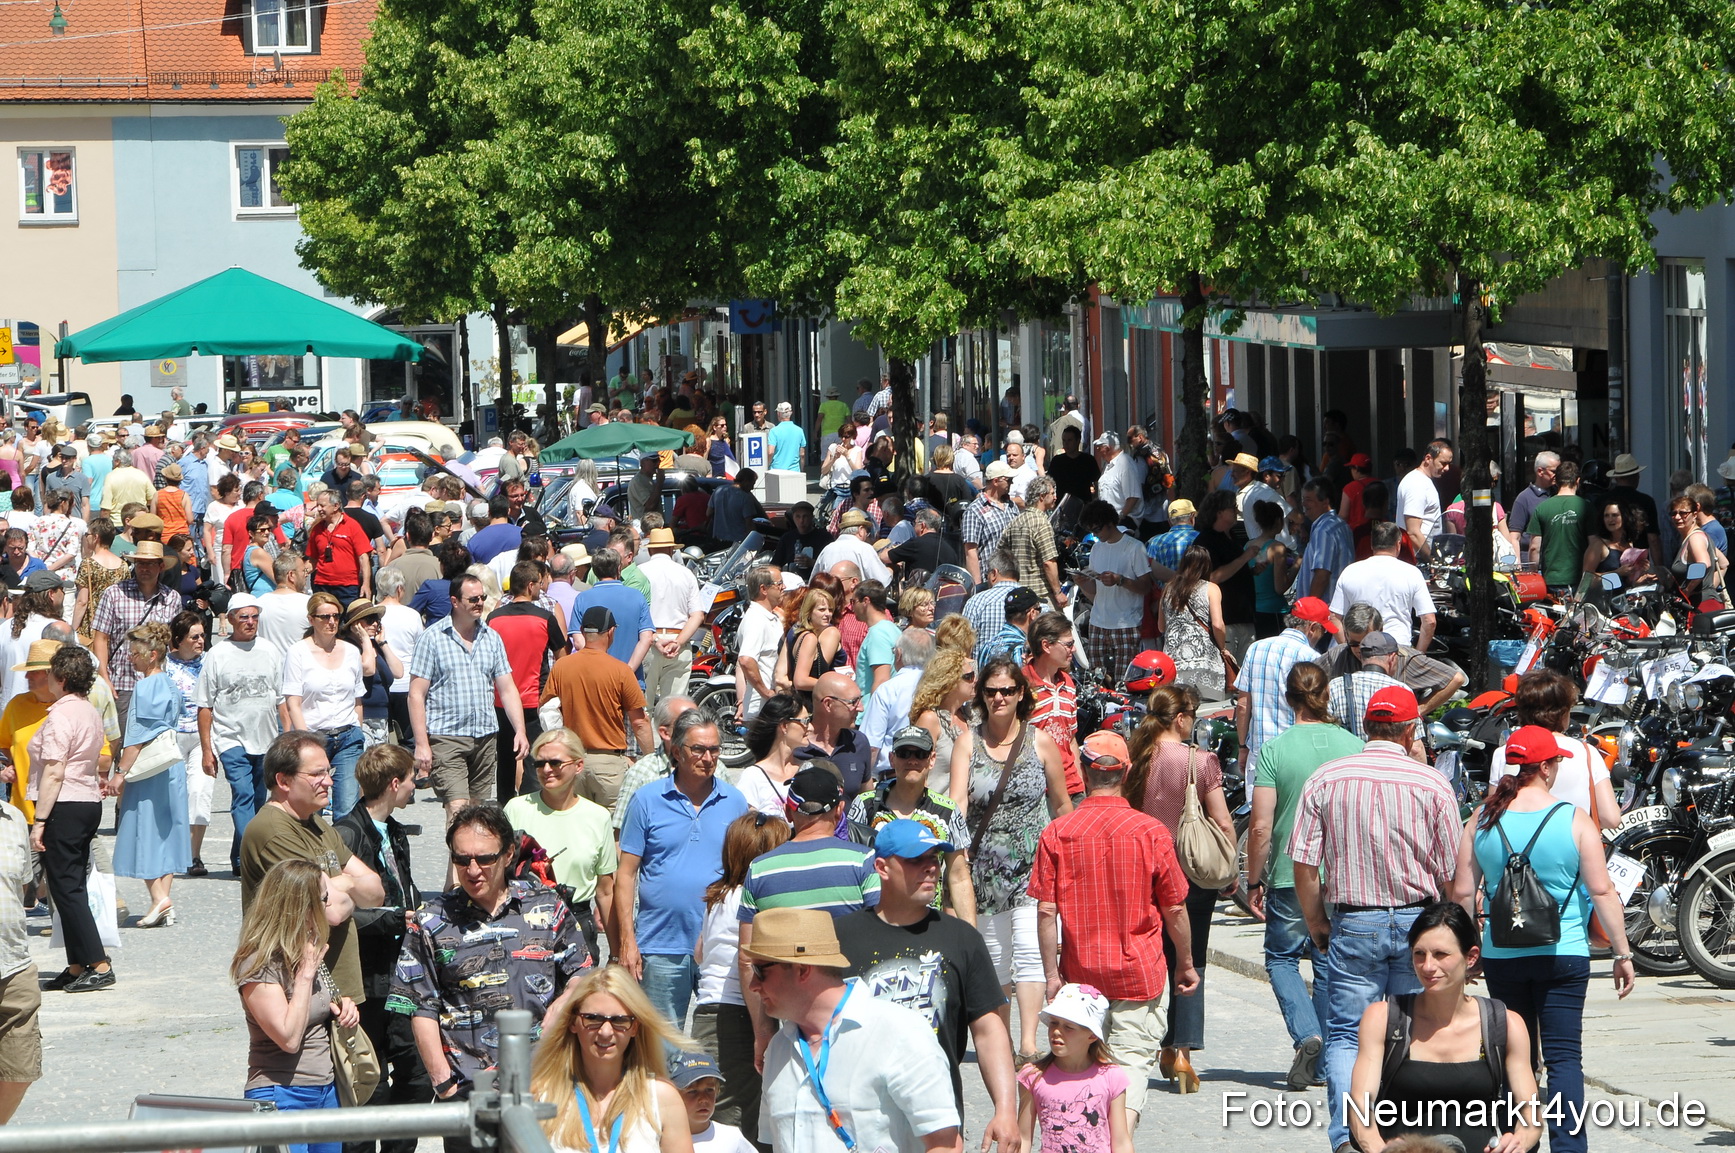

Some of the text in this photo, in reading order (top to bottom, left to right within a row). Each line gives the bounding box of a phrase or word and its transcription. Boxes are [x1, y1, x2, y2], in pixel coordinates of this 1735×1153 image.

[751, 440, 760, 455] P
[1664, 662, 1681, 673] 655
[1654, 807, 1669, 818] 39
[1607, 862, 1628, 878] 276
